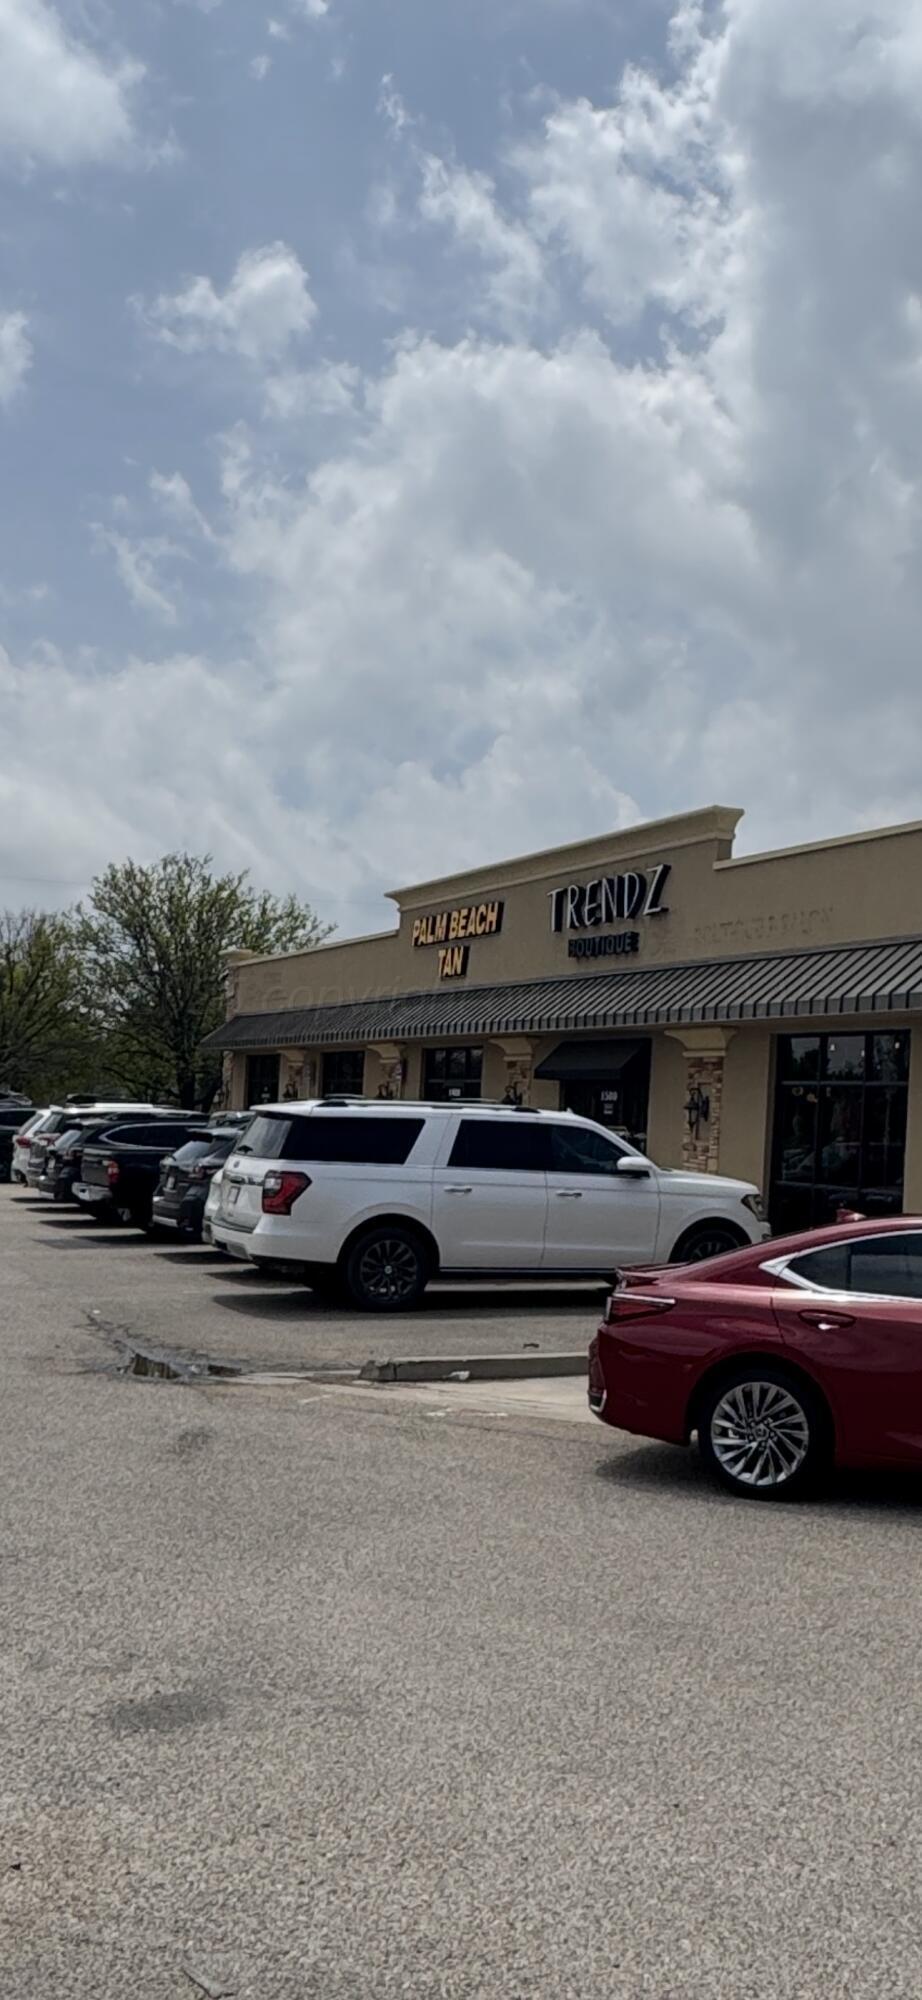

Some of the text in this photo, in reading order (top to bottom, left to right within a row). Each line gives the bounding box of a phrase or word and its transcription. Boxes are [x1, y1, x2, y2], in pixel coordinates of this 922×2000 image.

[547, 864, 665, 932] TRENDZ
[411, 902, 500, 947] PALM BEACH
[438, 946, 465, 977] TAN
